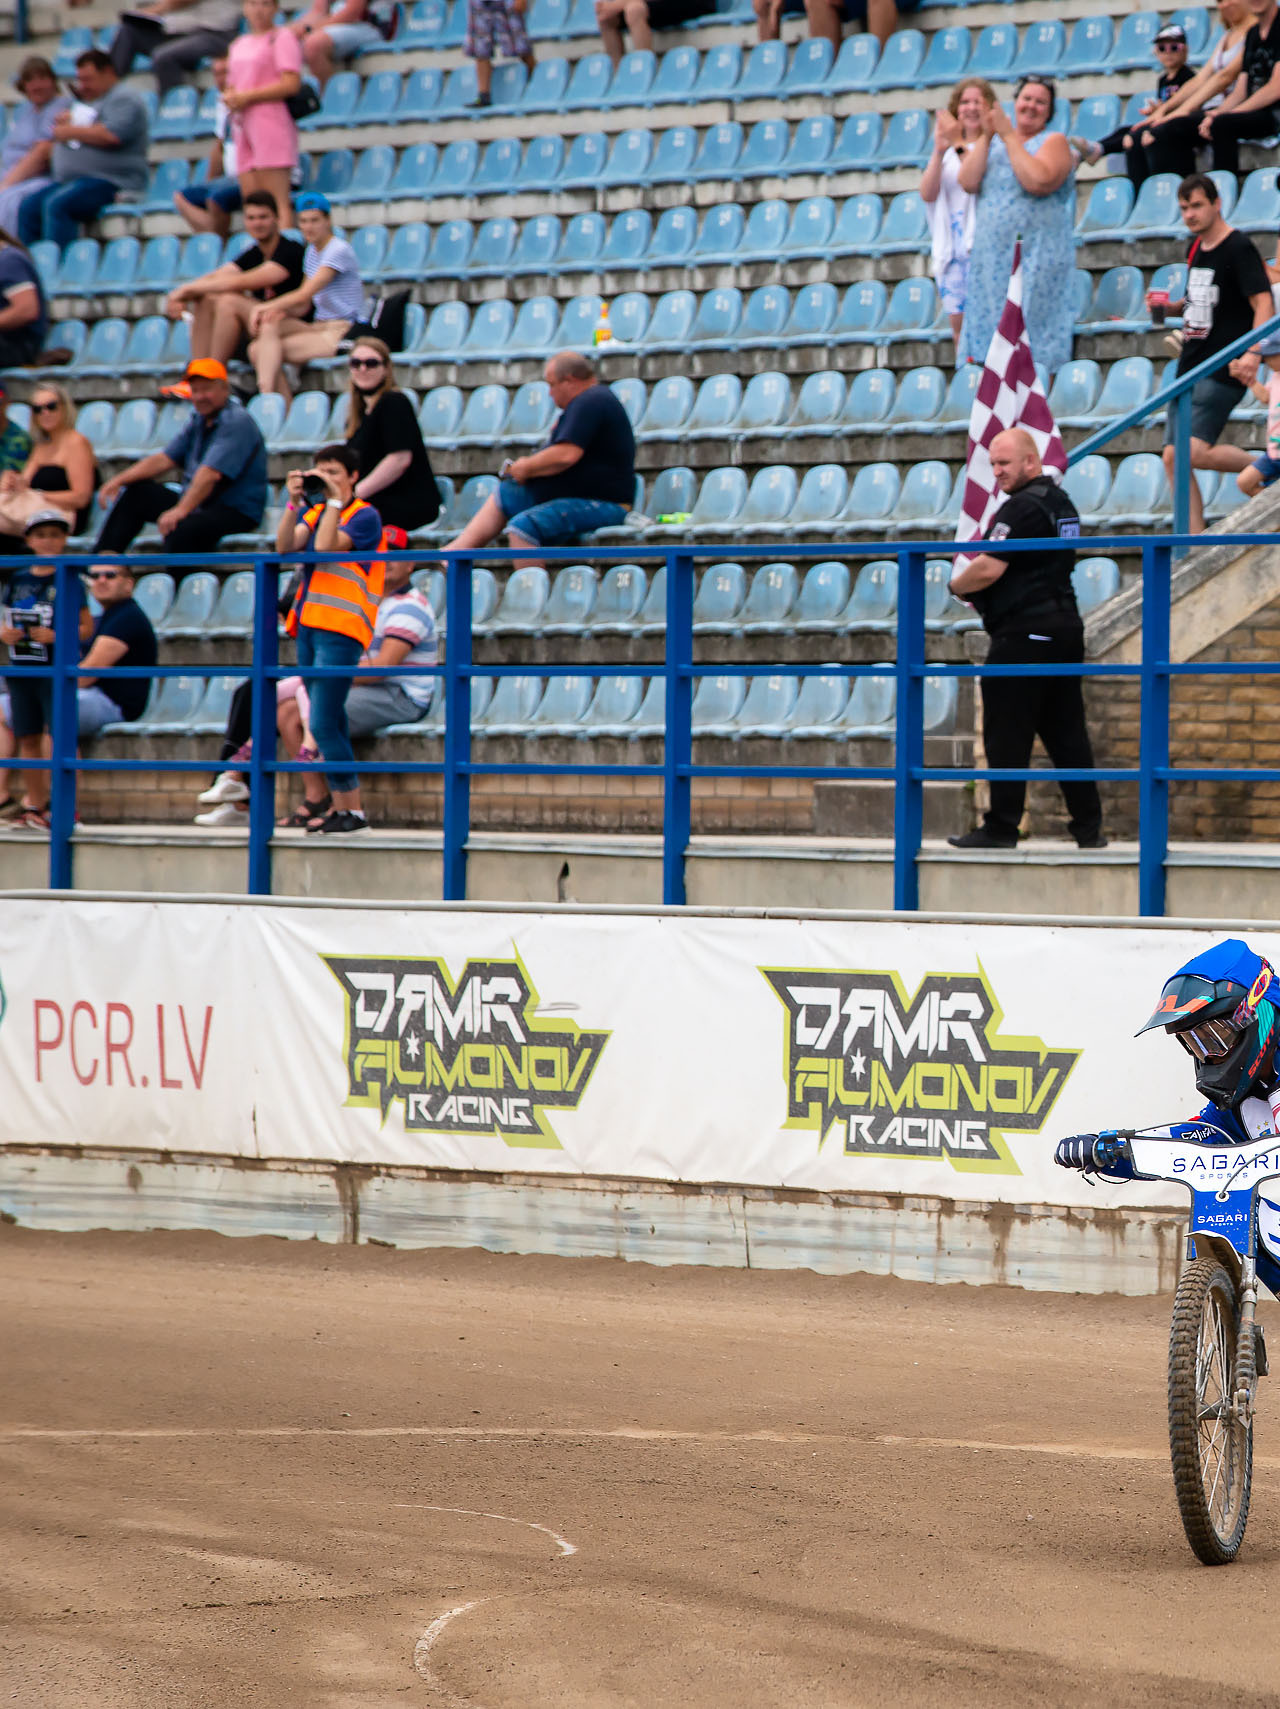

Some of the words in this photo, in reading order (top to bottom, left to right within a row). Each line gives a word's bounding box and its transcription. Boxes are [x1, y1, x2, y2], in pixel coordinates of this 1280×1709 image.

[345, 972, 526, 1051] DAMIR
[786, 986, 987, 1071] DAMIR
[34, 1000, 212, 1089] PCR.LV
[408, 1094, 532, 1126] RACING
[850, 1115, 988, 1150] RACING
[1173, 1154, 1279, 1173] SAGARI
[1197, 1213, 1248, 1224] SAGARI
